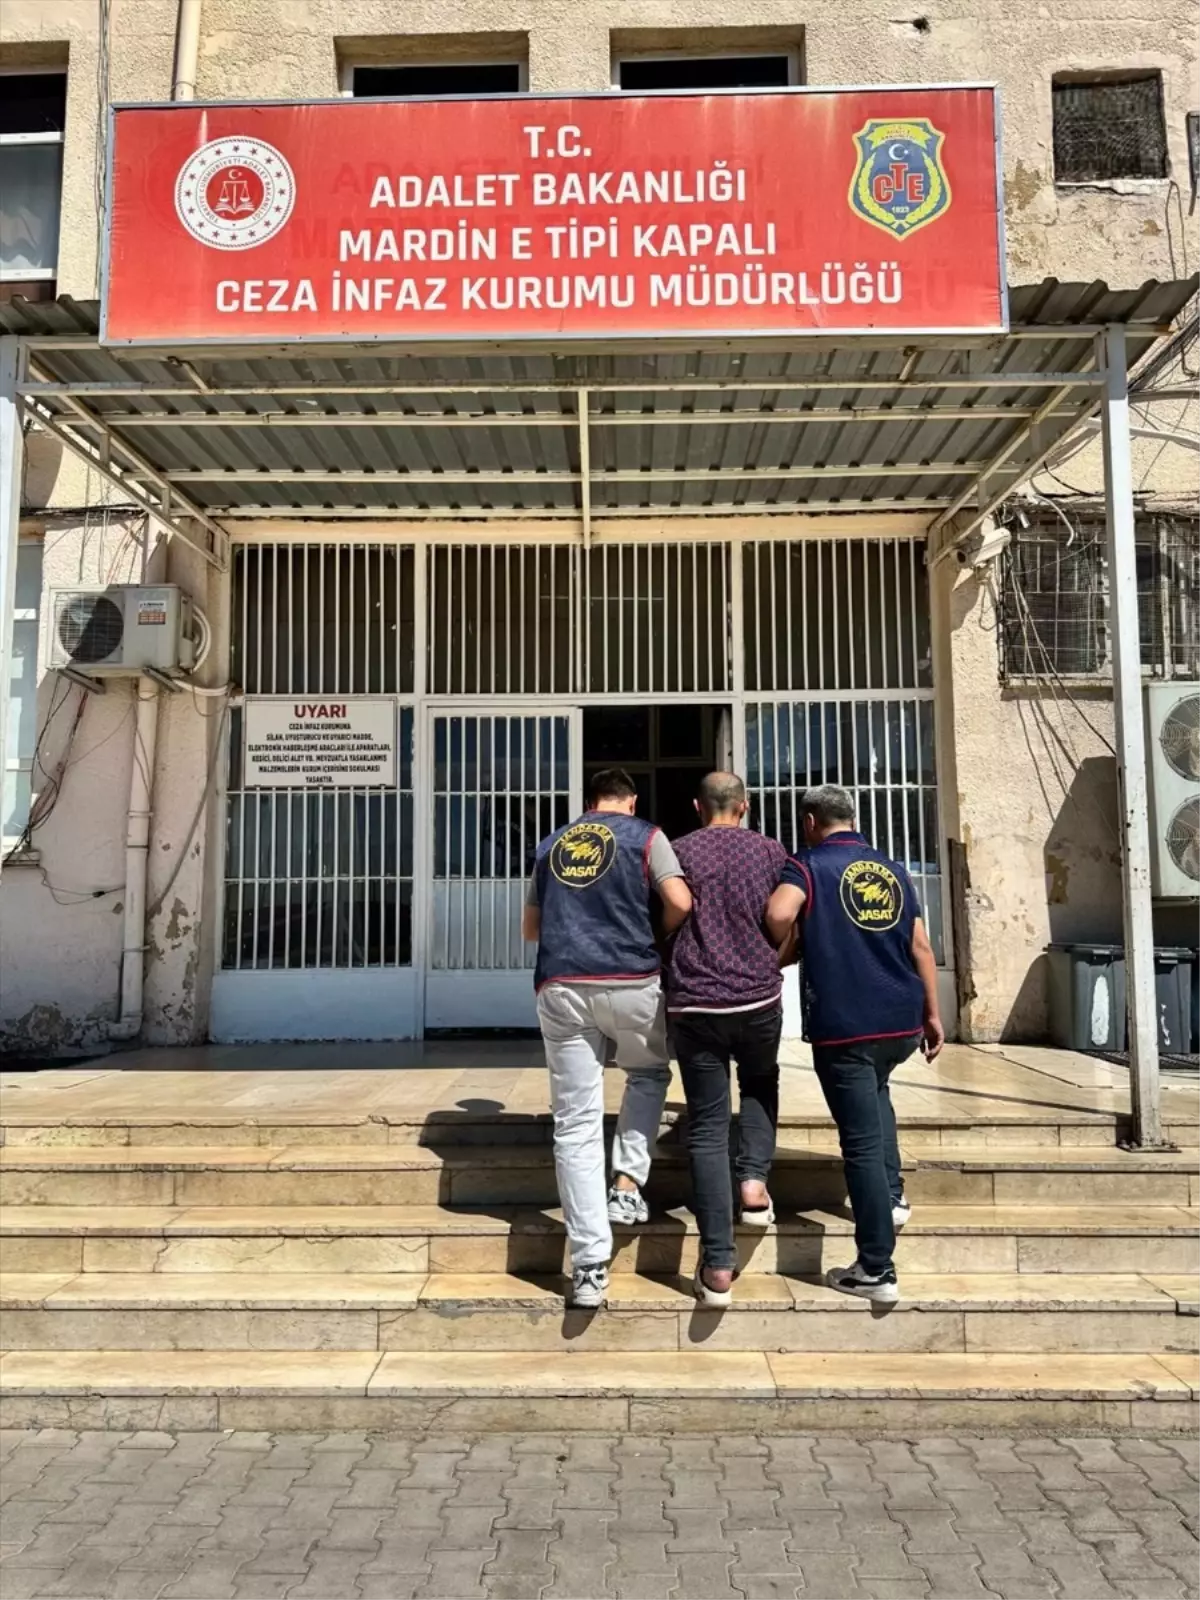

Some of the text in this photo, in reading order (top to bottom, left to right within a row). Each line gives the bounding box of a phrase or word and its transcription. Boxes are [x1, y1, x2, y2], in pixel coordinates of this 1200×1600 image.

[523, 125, 592, 159] T.C.
[370, 160, 747, 208] ADALET BAKANLIĞI
[872, 162, 925, 204] CTE
[339, 217, 777, 262] MARDİN E TİPİ KAPALI
[216, 263, 903, 312] CEZA İNFAZ KURUMU MÜDÜRLÜĞÜ
[294, 704, 347, 718] UYARI
[561, 865, 600, 878] JASAT
[857, 908, 894, 921] JASAT
